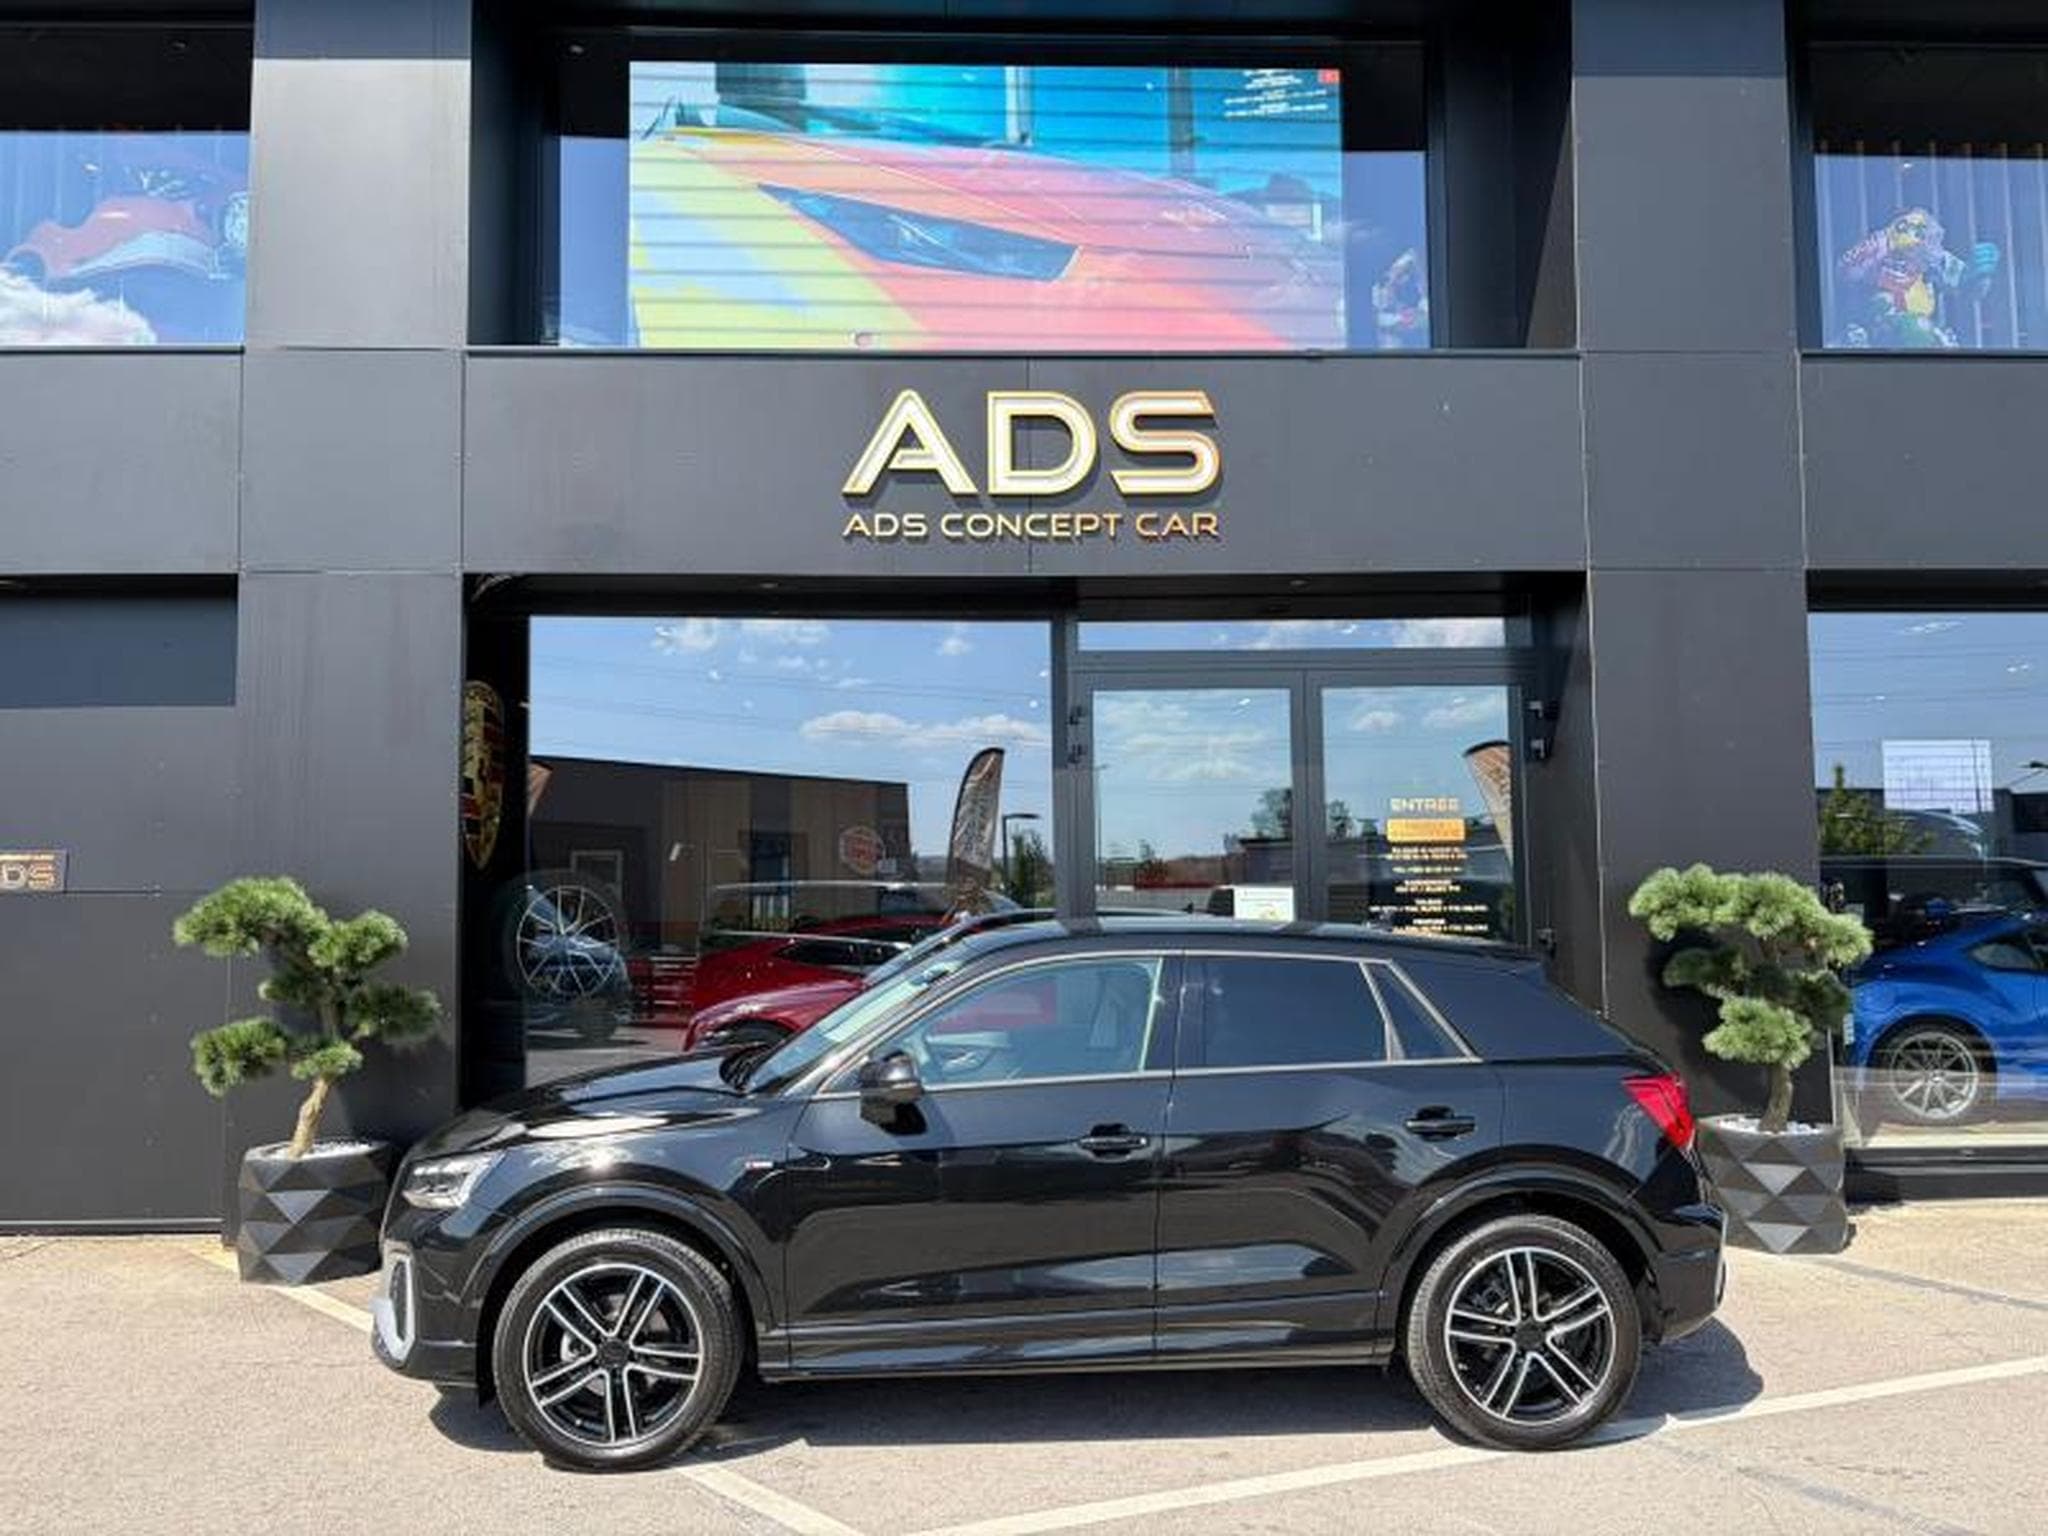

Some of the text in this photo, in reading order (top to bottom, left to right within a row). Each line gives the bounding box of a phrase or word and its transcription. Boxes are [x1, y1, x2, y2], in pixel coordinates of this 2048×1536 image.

[842, 388, 1221, 495] ADS
[842, 512, 1219, 537] ADS CONCEPT CAR
